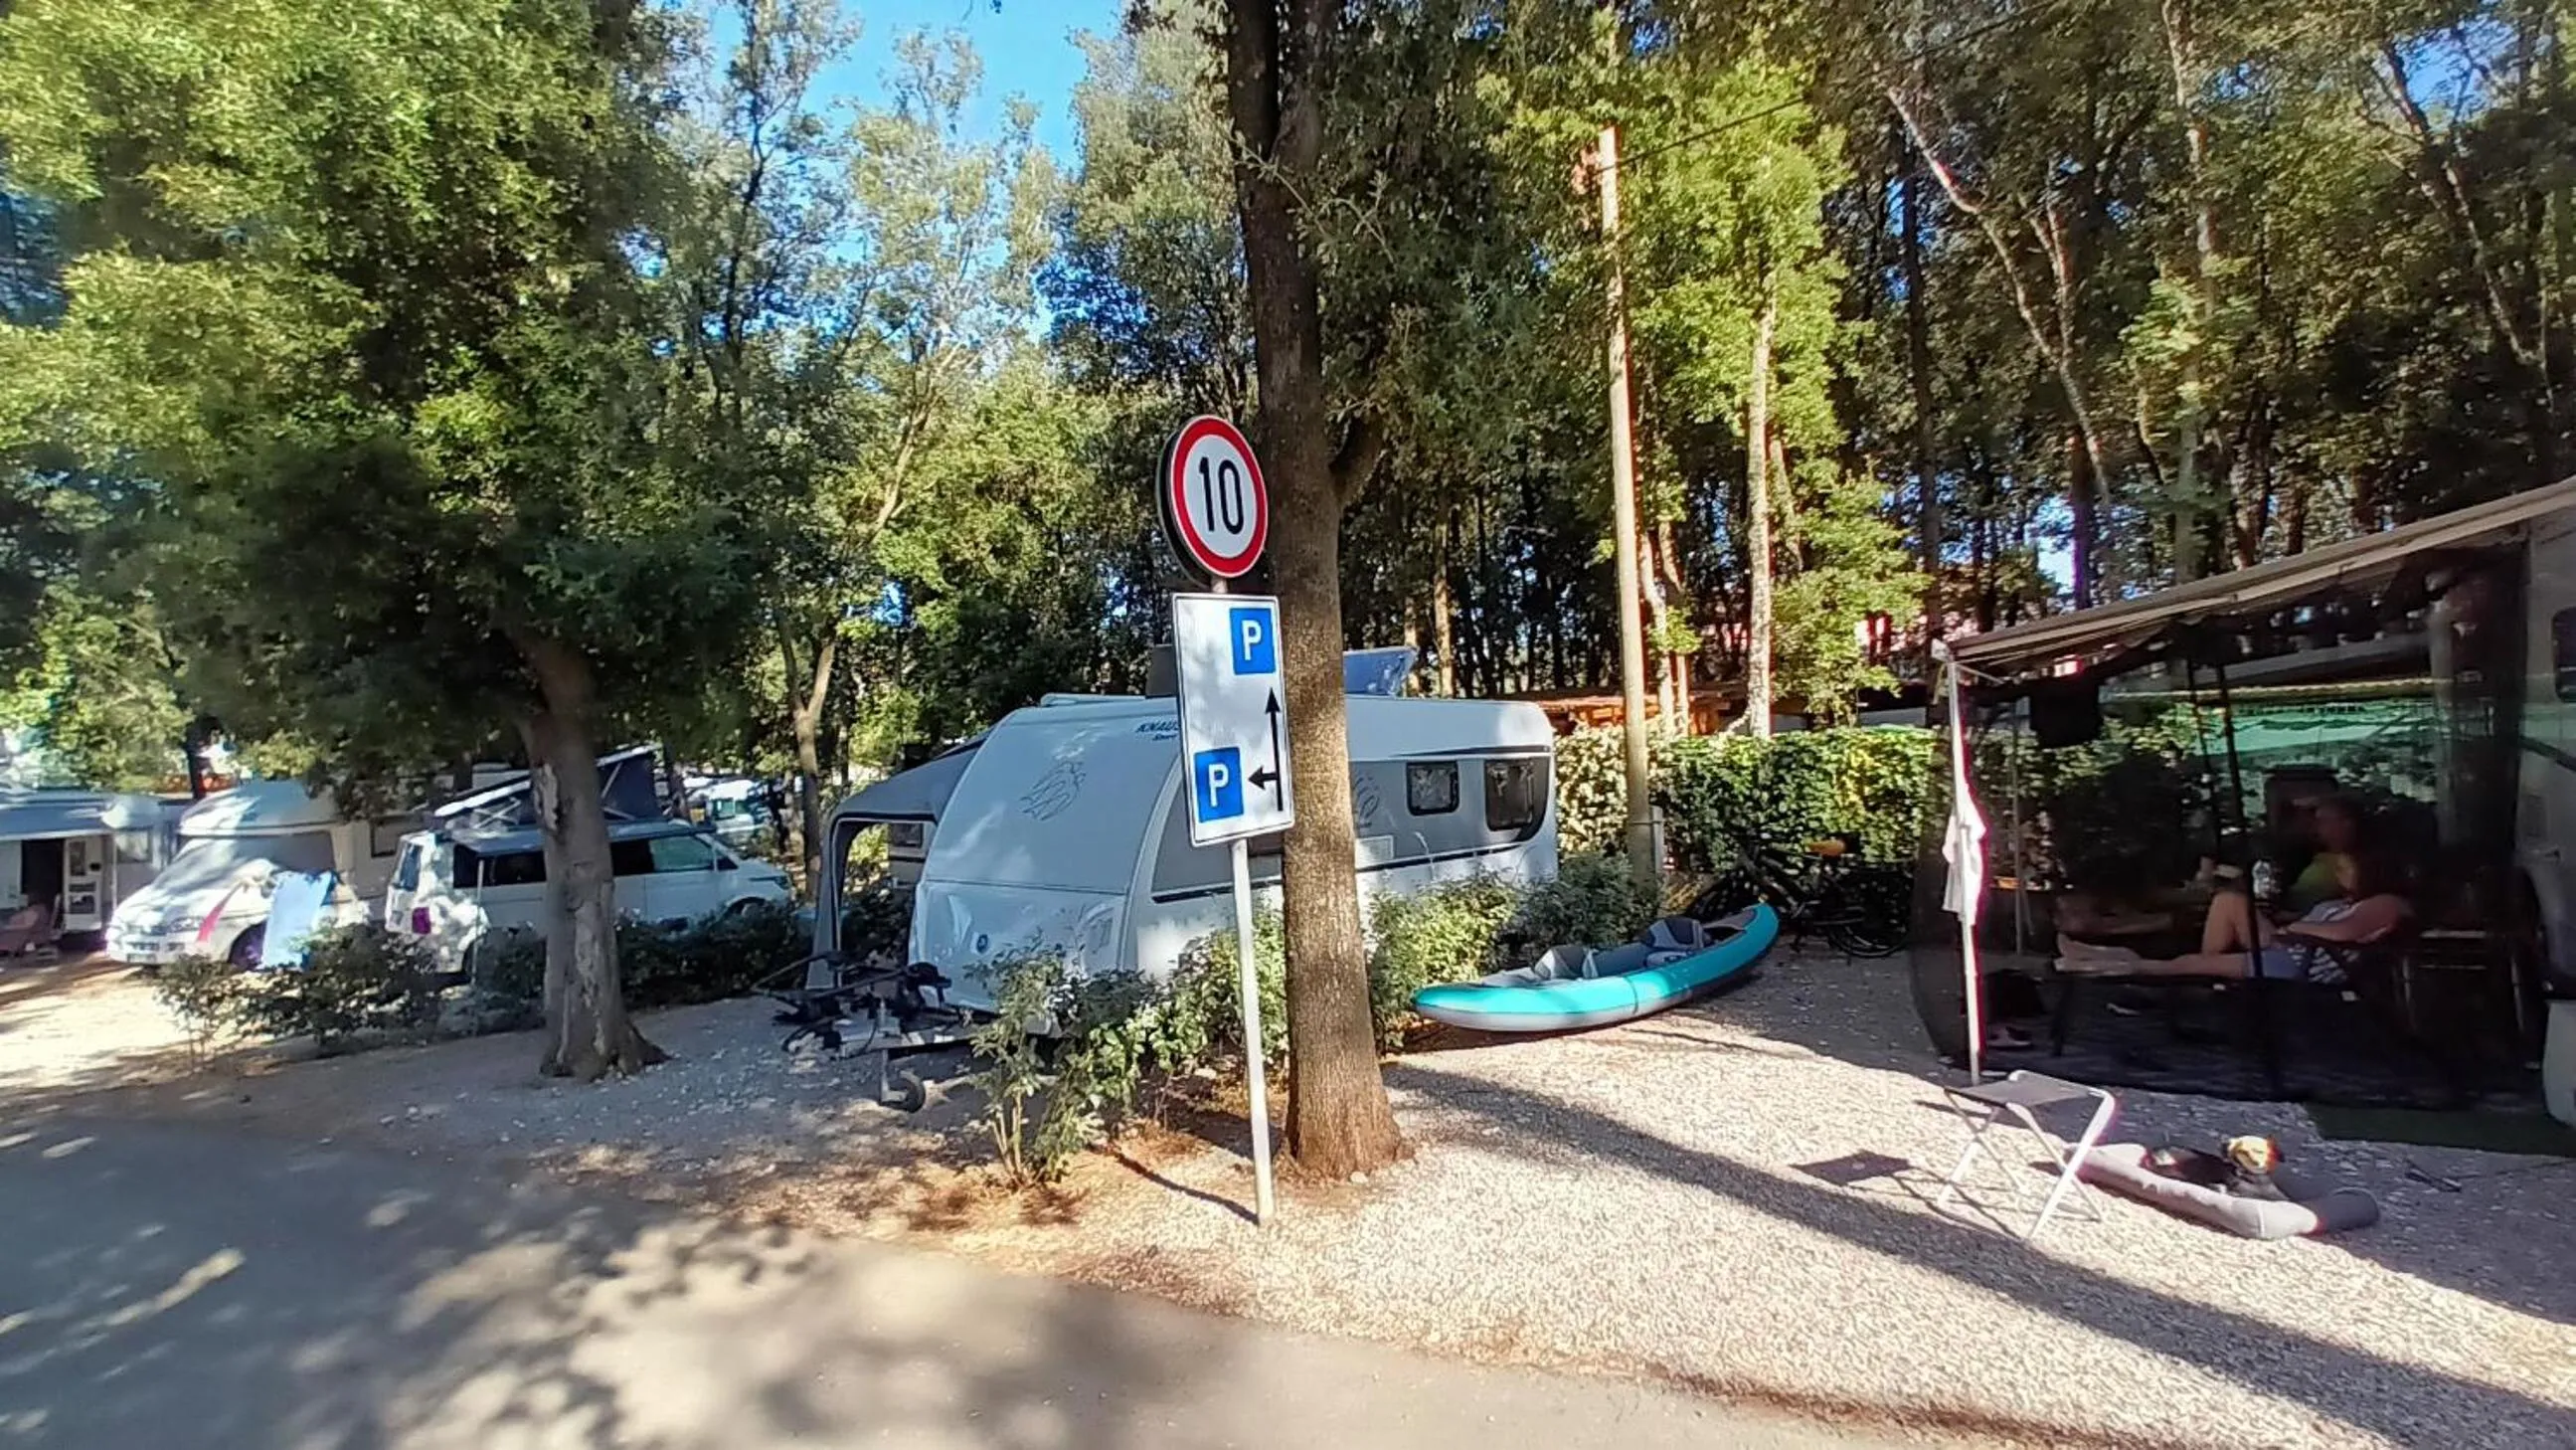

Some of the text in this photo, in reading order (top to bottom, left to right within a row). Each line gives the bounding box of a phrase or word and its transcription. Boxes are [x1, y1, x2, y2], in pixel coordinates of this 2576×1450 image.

[1199, 456, 1244, 534] 10
[1242, 620, 1262, 660] P
[1208, 763, 1229, 808] P
